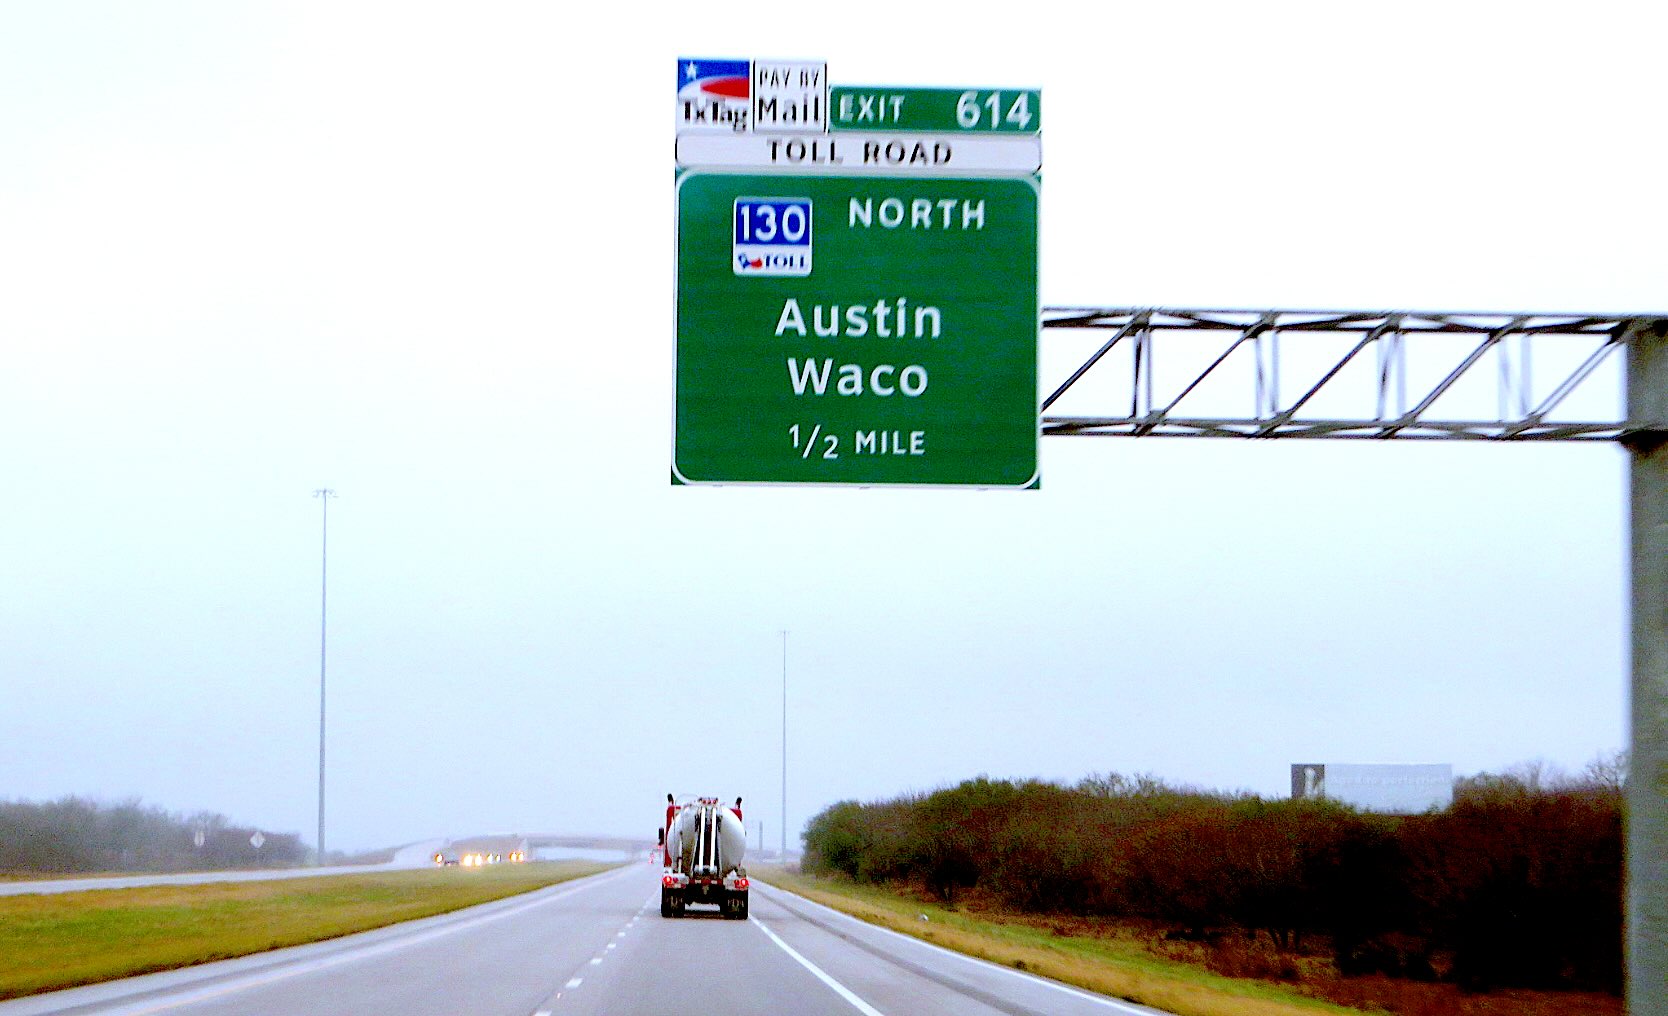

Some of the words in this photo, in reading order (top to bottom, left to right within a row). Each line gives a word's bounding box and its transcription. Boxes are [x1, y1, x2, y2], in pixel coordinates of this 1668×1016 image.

[759, 68, 791, 87] PAY
[799, 68, 820, 87] BY
[758, 94, 820, 122] Mail
[839, 94, 905, 123] EXIT
[955, 91, 1034, 129] 614
[766, 138, 844, 163] TOLL
[863, 141, 953, 165] ROAD
[740, 204, 807, 243] 130
[848, 197, 986, 230] NORTH
[763, 253, 808, 269] TOLL
[775, 297, 942, 339] Austin
[787, 357, 930, 398] Waco
[855, 430, 926, 456] MILE
